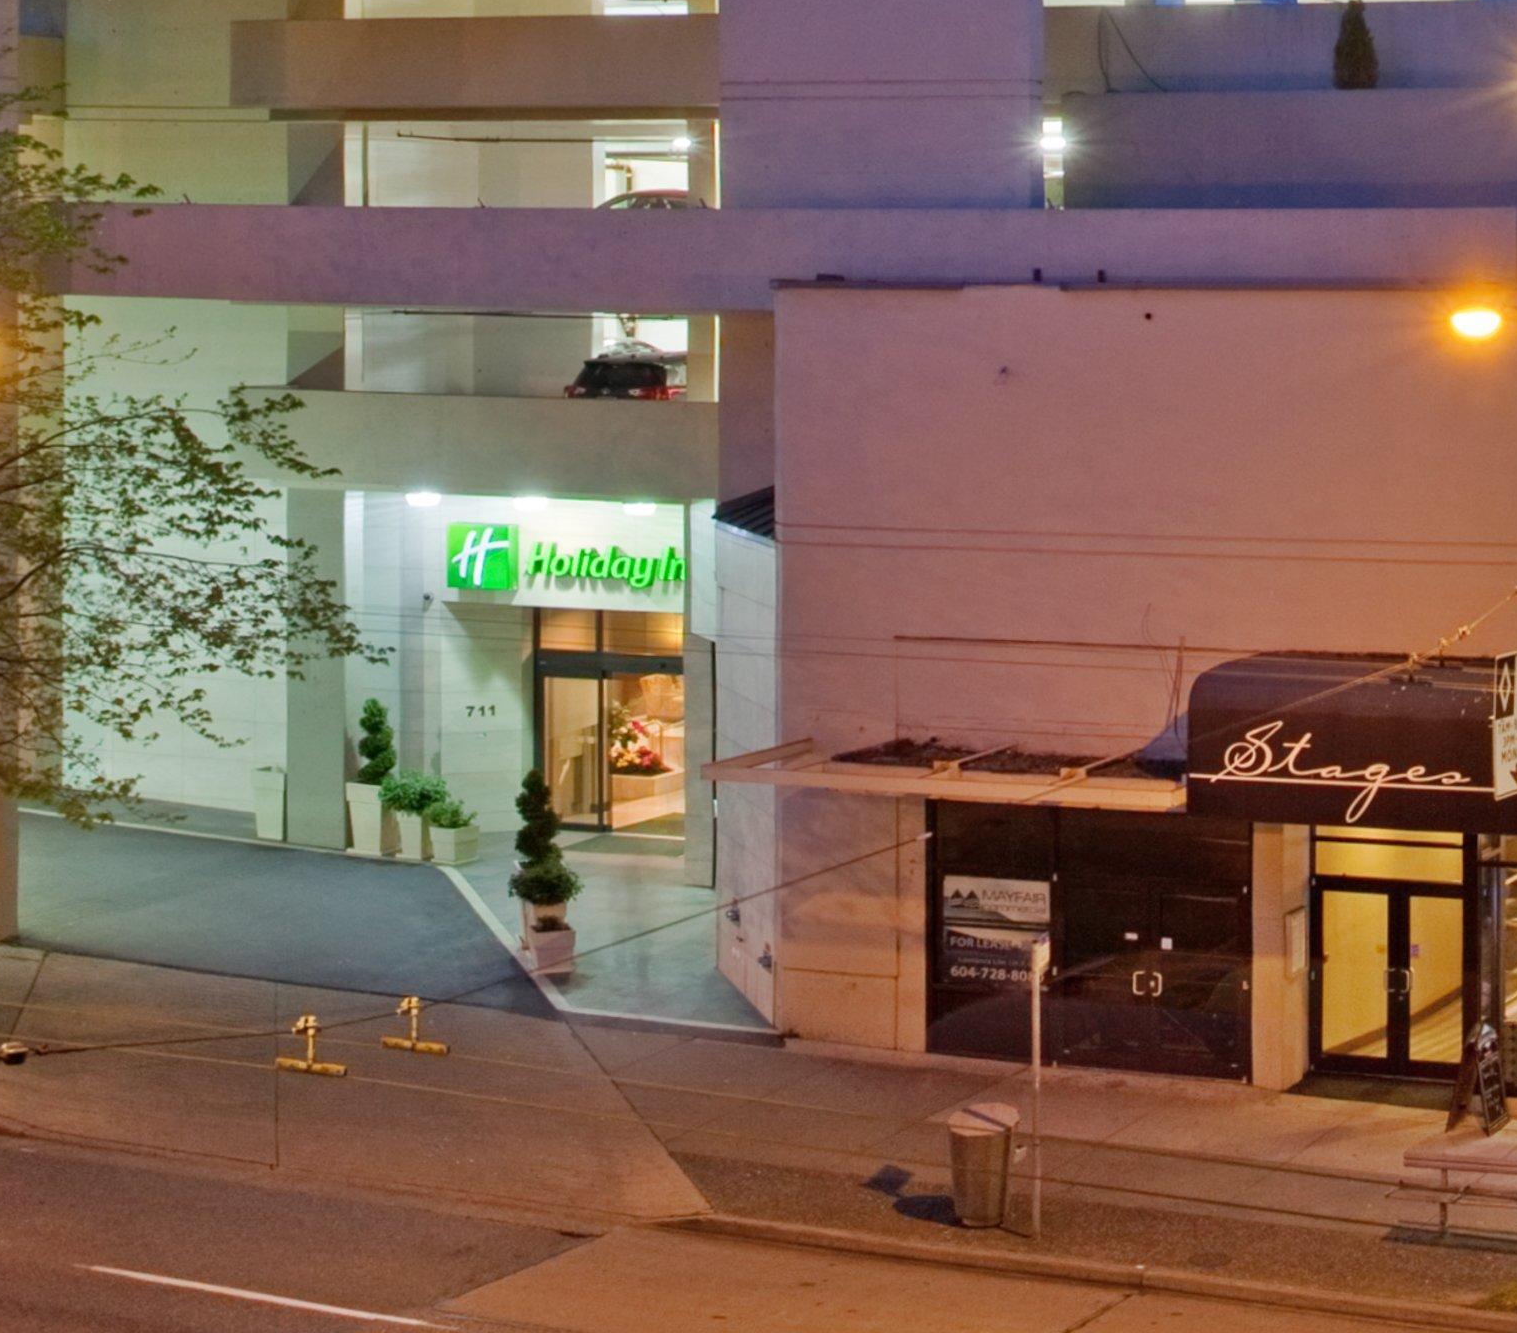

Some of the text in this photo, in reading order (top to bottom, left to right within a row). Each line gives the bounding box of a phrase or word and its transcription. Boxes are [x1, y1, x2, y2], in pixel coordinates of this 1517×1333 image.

[525, 542, 657, 588] Holiday
[465, 704, 496, 717] 711
[1210, 720, 1471, 824] Stages
[982, 889, 1046, 903] MAYFAIR
[950, 936, 974, 948] FOR
